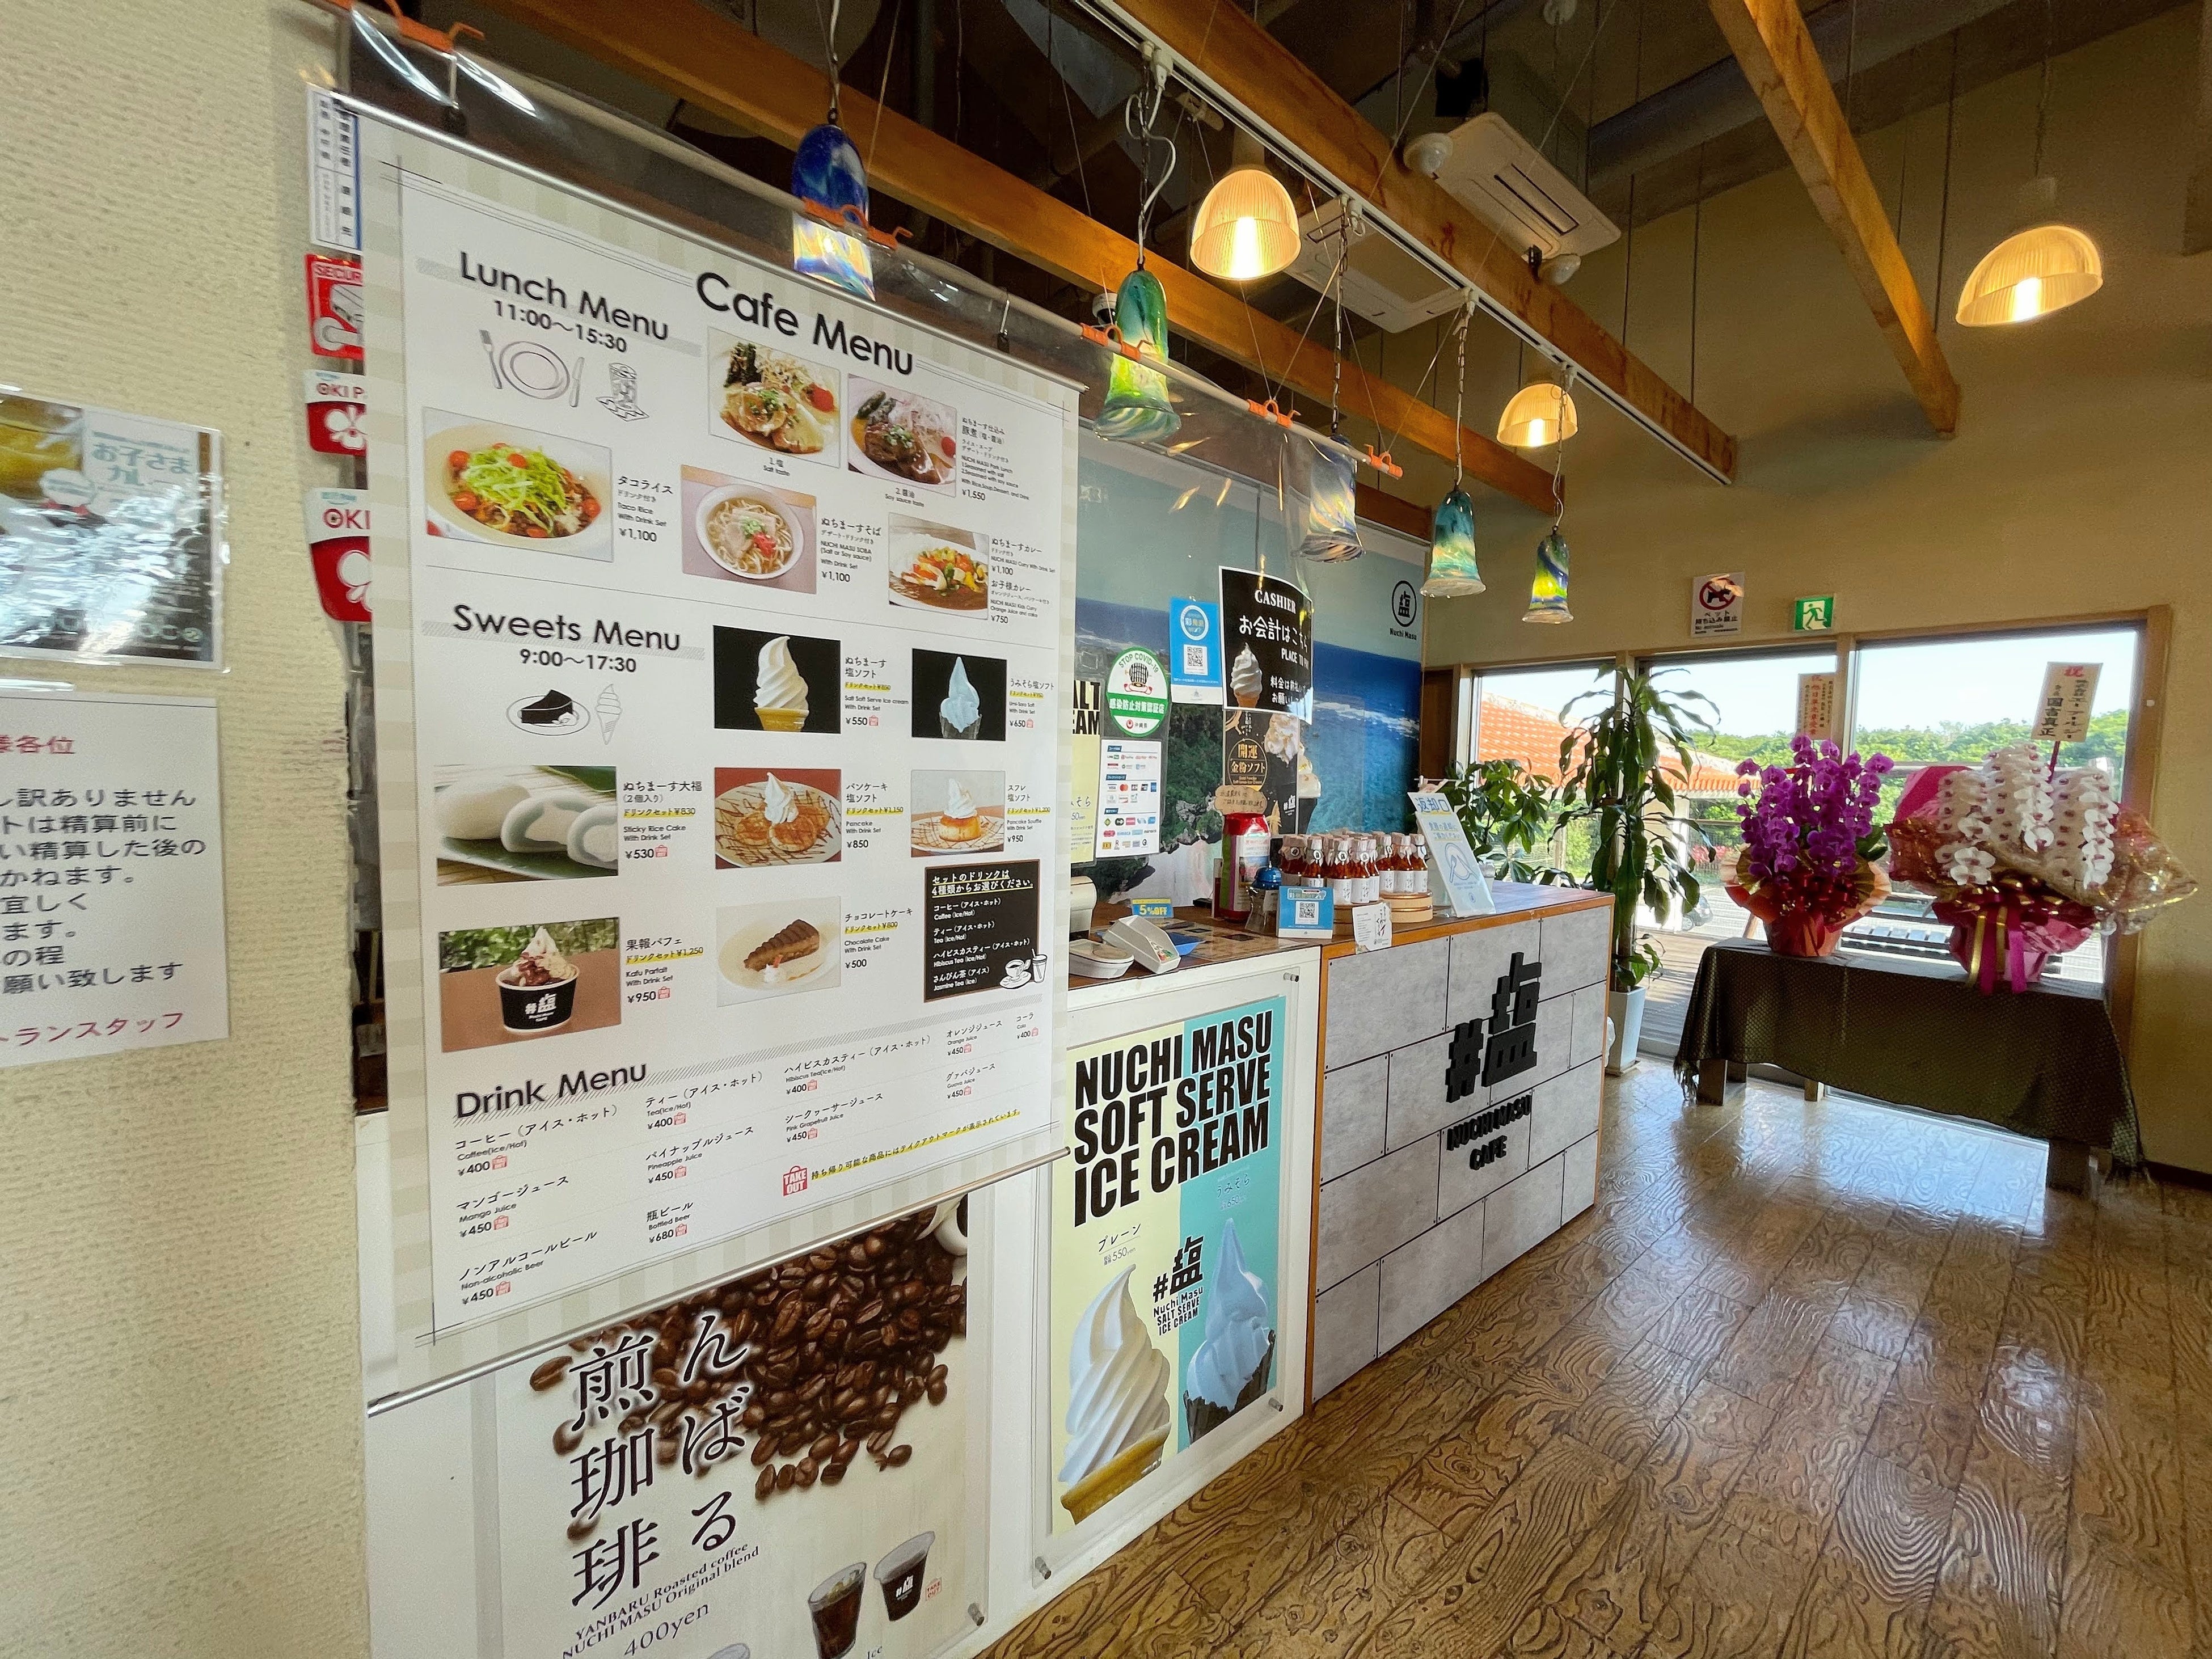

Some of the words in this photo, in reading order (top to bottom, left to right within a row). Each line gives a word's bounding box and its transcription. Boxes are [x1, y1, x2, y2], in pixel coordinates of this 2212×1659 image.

[461, 251, 566, 309] Lunch
[579, 290, 669, 340] Menu
[696, 272, 799, 336] Cafe
[813, 314, 914, 376] Menu
[618, 475, 674, 495] タコライス
[962, 488, 986, 501] ¥1,550
[618, 527, 657, 542] ¥1,100
[821, 517, 882, 537] ぬちまーすそば
[821, 571, 851, 582] ¥1,100
[991, 565, 1014, 576] ¥1,100
[1254, 589, 1297, 615] CASHIER
[990, 614, 1009, 624] ¥750
[1695, 615, 1738, 624] 持ち込み禁止
[453, 603, 582, 643] Sweets
[593, 619, 681, 652] Menu
[1239, 614, 1308, 653] お会計はこちら
[1389, 627, 1404, 638] Nuchi
[1404, 631, 1417, 641] Masu
[845, 656, 887, 669] ぬちまーす
[1118, 653, 1133, 669] STOP
[1134, 652, 1159, 674] COVID-19
[1281, 648, 1298, 664] PLACE
[845, 667, 877, 679] 塩ソフト
[845, 716, 868, 726] ¥550
[1073, 710, 1100, 735] AM
[623, 780, 703, 792] ぬちまーす大福
[845, 783, 888, 792] パンケーキ
[845, 793, 877, 803] 塩ソフト
[1007, 793, 1031, 802] 塩ソフト
[1415, 796, 1450, 813] 返却口
[846, 839, 869, 849] ¥850
[1007, 834, 1024, 843] ¥950
[624, 848, 655, 859] ¥530
[932, 869, 1010, 884] セットのドリンクは
[931, 879, 1034, 896] 4種類からお選びください。
[845, 907, 914, 923] チョコレートケーキ
[626, 936, 683, 952] 果報パフェ
[844, 938, 874, 947] Chocolate
[3, 945, 65, 966] の程
[845, 958, 867, 969] ¥500
[3, 963, 184, 994] 願い致します
[627, 990, 657, 1003] ¥950
[1016, 1012, 1035, 1023] コーラ
[0, 1012, 184, 1047] ランスタッフ
[946, 1020, 1003, 1039] オレンジジュース
[1016, 1030, 1031, 1040] ¥400
[947, 1037, 965, 1046] Orange
[947, 1046, 964, 1057] ¥450
[1075, 1034, 1184, 1110] NUCHI
[1192, 1010, 1273, 1074] MASU
[945, 1063, 996, 1083] グァバジュース
[456, 1079, 547, 1118] Drink
[558, 1063, 647, 1098] Menu
[786, 1083, 807, 1095] ¥400
[947, 1089, 964, 1100] ¥450
[1074, 1086, 1168, 1165] SOFT
[1176, 1053, 1271, 1129] SERVE
[647, 1117, 673, 1130] ¥400
[829, 1113, 845, 1122] Juice
[1446, 1111, 1493, 1152] NUCHI
[1494, 1094, 1533, 1130] MASU
[645, 1126, 754, 1161] パイナップルジュース
[786, 1130, 807, 1143] ¥450
[684, 1152, 703, 1162] Juice
[1469, 1134, 1508, 1171] CAFE
[457, 1160, 491, 1176] ¥400
[1074, 1148, 1139, 1228] ICE
[1151, 1100, 1269, 1194] CREAM
[648, 1170, 674, 1184] ¥450
[783, 1169, 808, 1186] TAKE
[1217, 1172, 1250, 1198] うみそら
[456, 1175, 569, 1210] マンゴージュース
[786, 1180, 805, 1195] OUT
[459, 1209, 491, 1223] Mango
[494, 1202, 517, 1214] Juice
[646, 1201, 694, 1223] 瓶ビール
[674, 1213, 691, 1223] Beer
[459, 1221, 492, 1238] ¥450
[649, 1229, 674, 1244] ¥680
[1098, 1222, 1141, 1253] プレーン
[459, 1231, 598, 1282] ノンアルコールビール
[525, 1260, 545, 1271] Beer
[1152, 1235, 1204, 1304] #塩
[462, 1287, 494, 1305] ¥450
[1153, 1295, 1179, 1319] Nuchi
[1180, 1286, 1204, 1302] Masu
[1156, 1309, 1175, 1326] SALT
[1177, 1295, 1200, 1315] SERVE
[1158, 1320, 1171, 1336] ICE
[1173, 1307, 1199, 1328] CREAM
[575, 1593, 650, 1641] YANBARU
[653, 1562, 708, 1599] Roasted
[710, 1543, 749, 1569] coffee
[562, 1626, 616, 1659] NUCHI
[619, 1598, 662, 1631] MASU
[665, 1569, 721, 1605] Original
[724, 1545, 760, 1572] blend
[623, 1603, 710, 1657] 400yen
